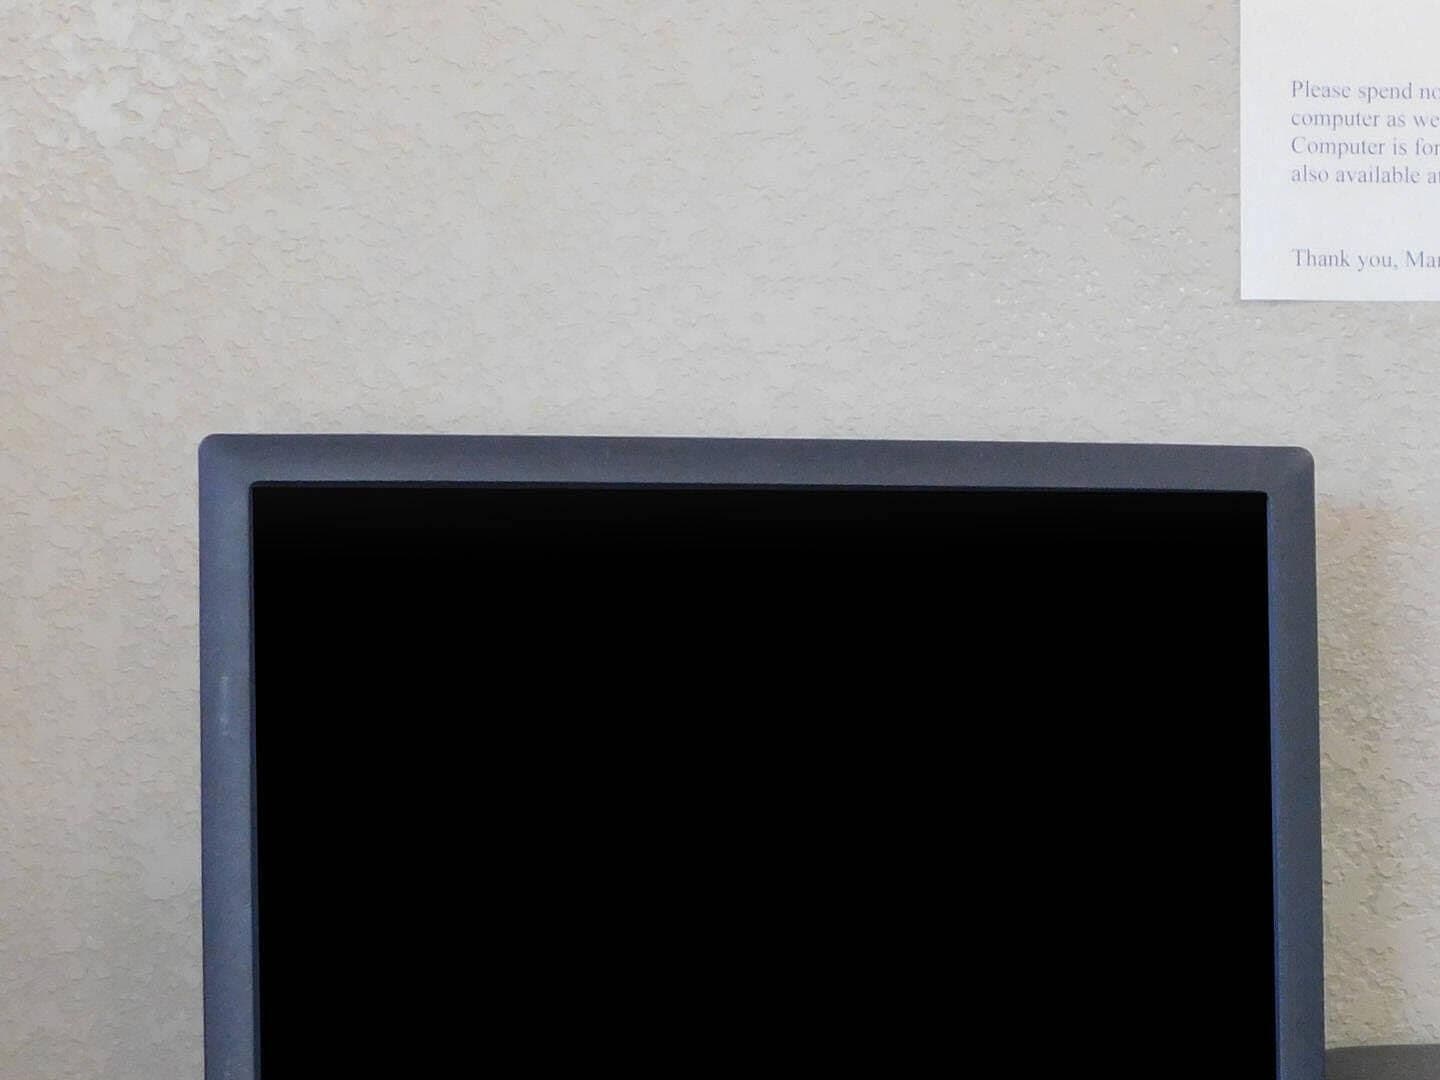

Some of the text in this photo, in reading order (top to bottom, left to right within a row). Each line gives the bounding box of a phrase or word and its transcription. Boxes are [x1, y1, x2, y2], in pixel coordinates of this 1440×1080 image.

[1291, 79, 1352, 99] Please
[1357, 81, 1413, 105] spend
[1290, 111, 1381, 132] computer
[1386, 114, 1407, 128] as
[1412, 114, 1440, 129] we
[1290, 136, 1386, 160] Computer
[1392, 137, 1408, 156] is
[1290, 163, 1330, 183] also
[1335, 165, 1421, 185] available
[1291, 247, 1351, 268] Thank
[1356, 254, 1399, 273] you,
